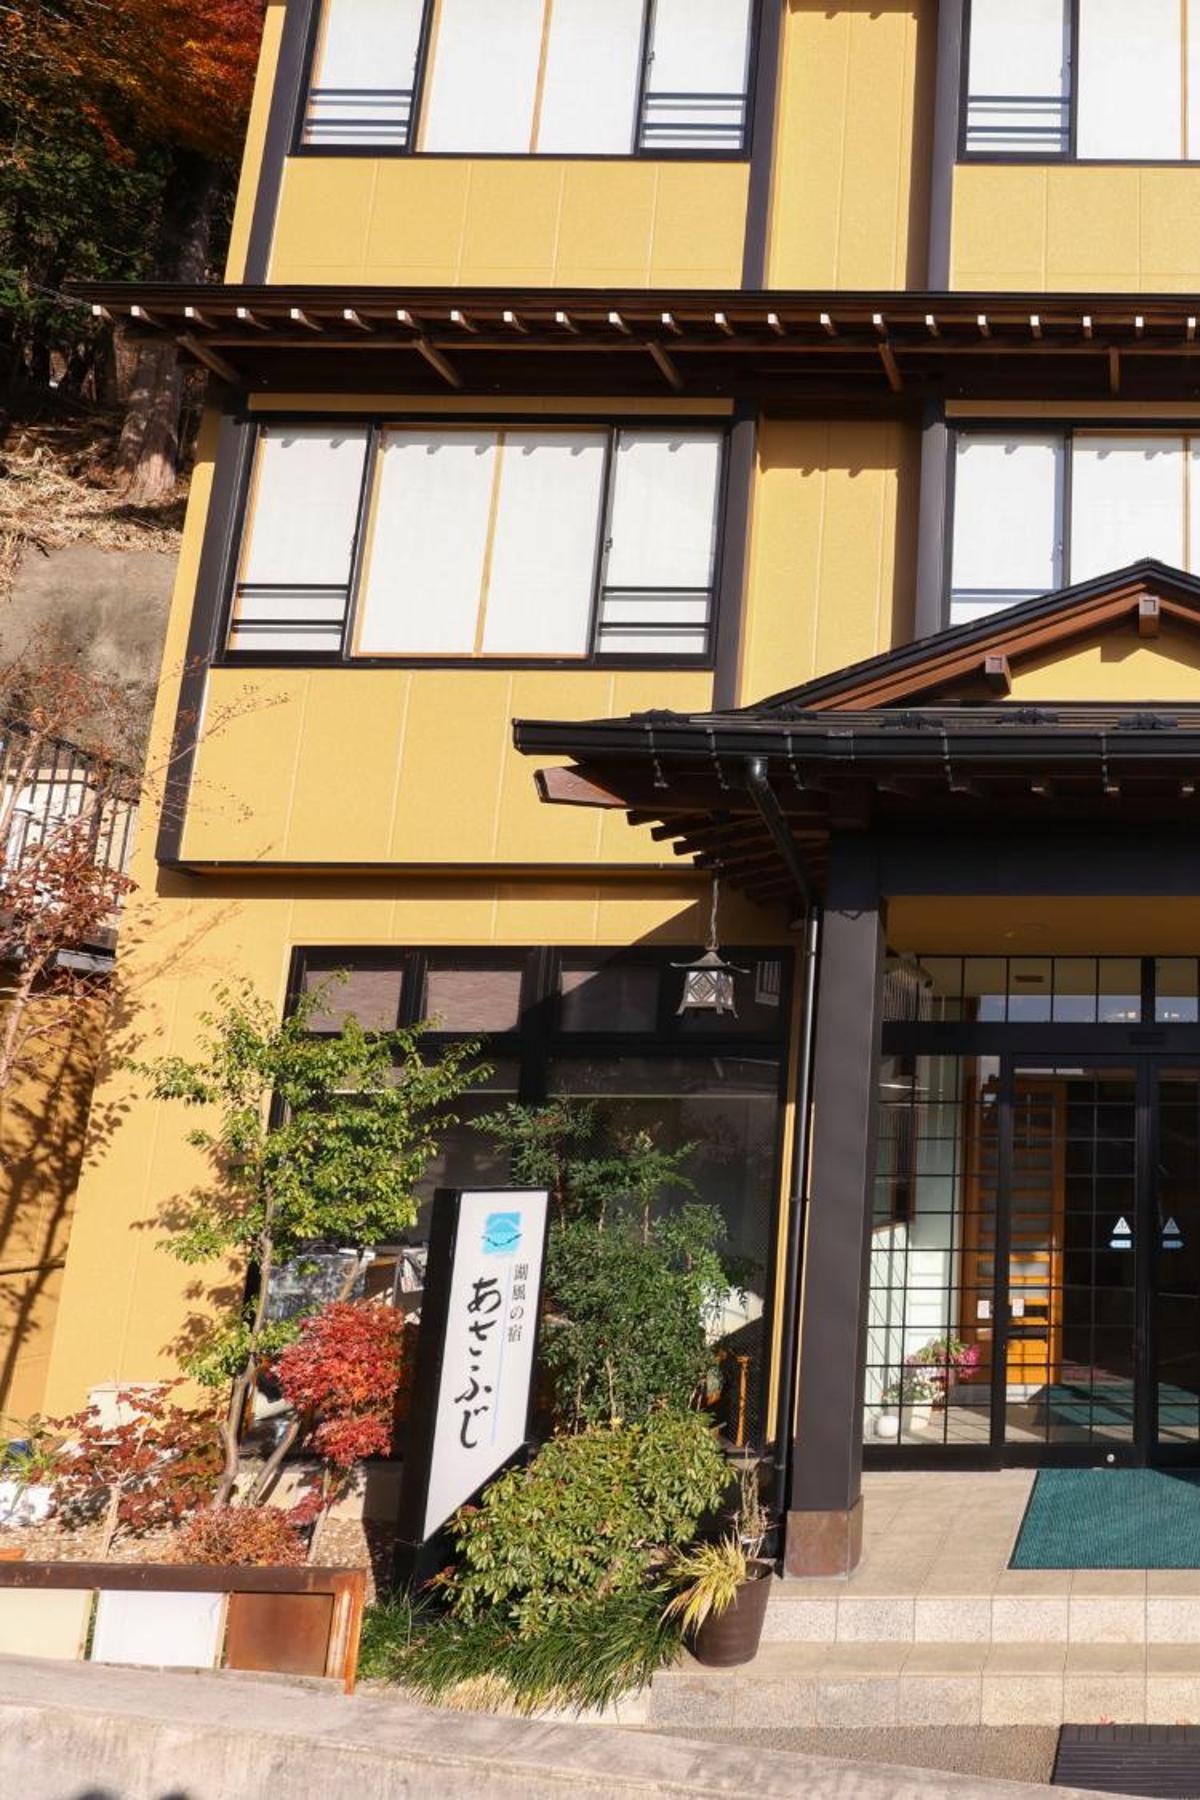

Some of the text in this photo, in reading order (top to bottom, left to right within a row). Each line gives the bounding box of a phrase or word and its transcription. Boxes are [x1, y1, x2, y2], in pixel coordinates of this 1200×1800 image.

[454, 1276, 502, 1449] あさふじ
[507, 1263, 529, 1343] 湖風の宿
